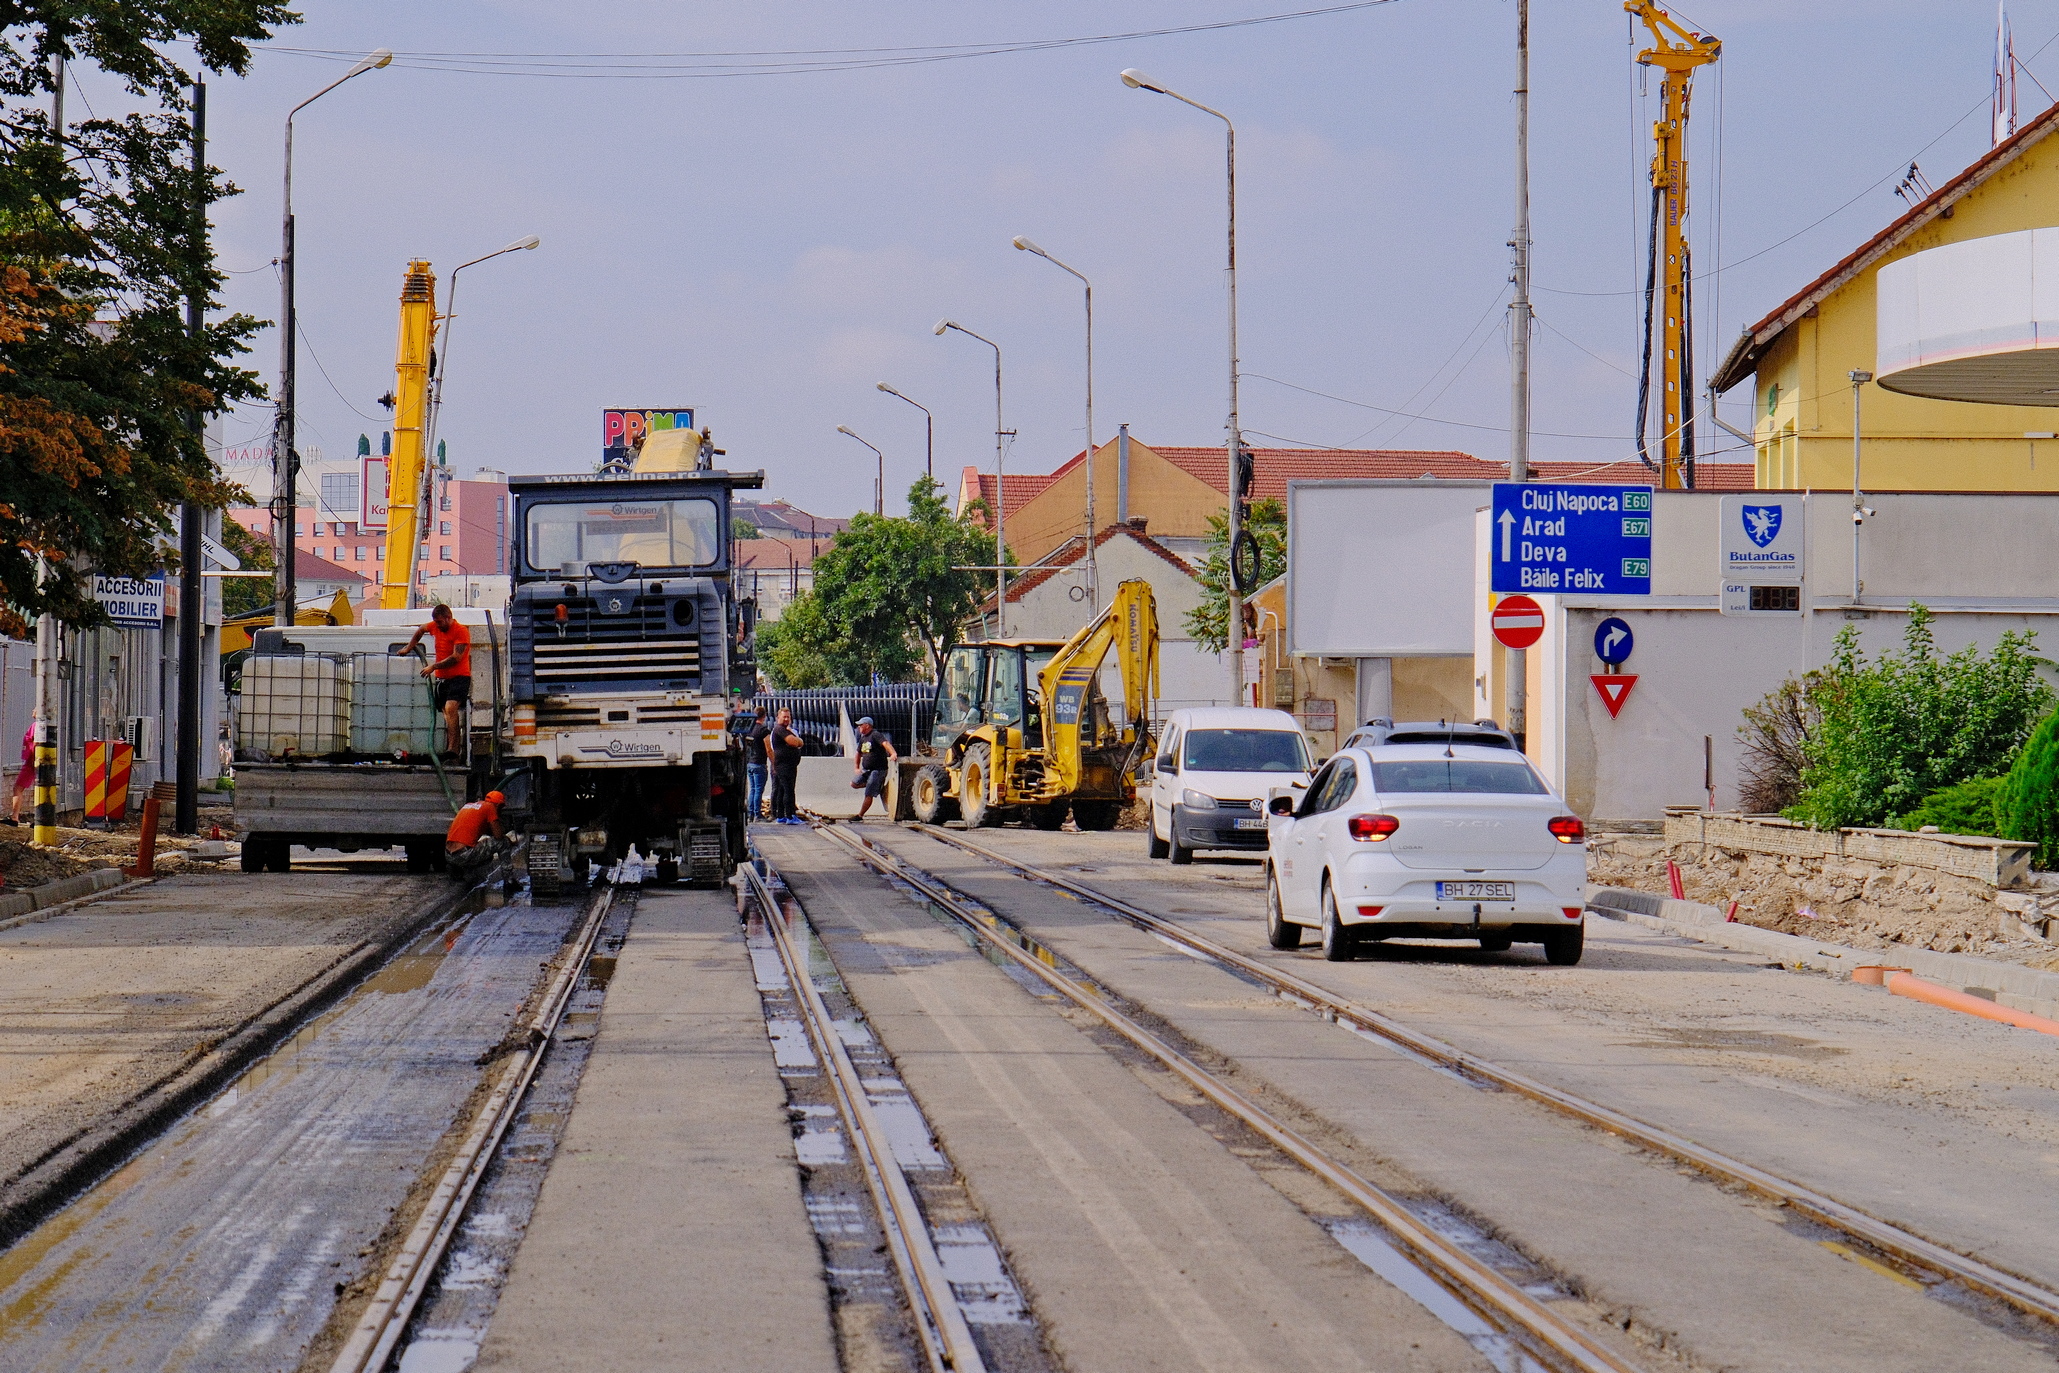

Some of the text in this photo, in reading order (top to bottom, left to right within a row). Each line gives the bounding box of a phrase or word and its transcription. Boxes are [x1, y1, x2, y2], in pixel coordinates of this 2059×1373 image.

[1671, 170, 1678, 180] 23
[1671, 182, 1678, 195] BG
[1670, 199, 1678, 226] BAUER
[544, 471, 700, 483] www.selina.ro
[1522, 489, 1619, 515] Cluj Napoca
[1624, 494, 1648, 508] E60
[624, 506, 657, 515] Wirtgen
[1522, 515, 1566, 536] Arad
[1623, 520, 1648, 534] E671
[1521, 541, 1567, 562] Deva
[1729, 551, 1795, 561] ButanGas
[1624, 561, 1647, 575] E79
[1520, 566, 1605, 588] Băile Felix
[96, 579, 162, 597] ACCESORII
[1726, 585, 1746, 593] GPL
[101, 599, 158, 617] MOBILIER
[1129, 603, 1139, 653] KOMATSU
[1060, 695, 1075, 703] WB
[1056, 704, 1078, 714] 93R
[624, 742, 661, 753] Wirtgen
[1239, 819, 1251, 828] BH
[1444, 884, 1512, 897] BH 27 SEL
